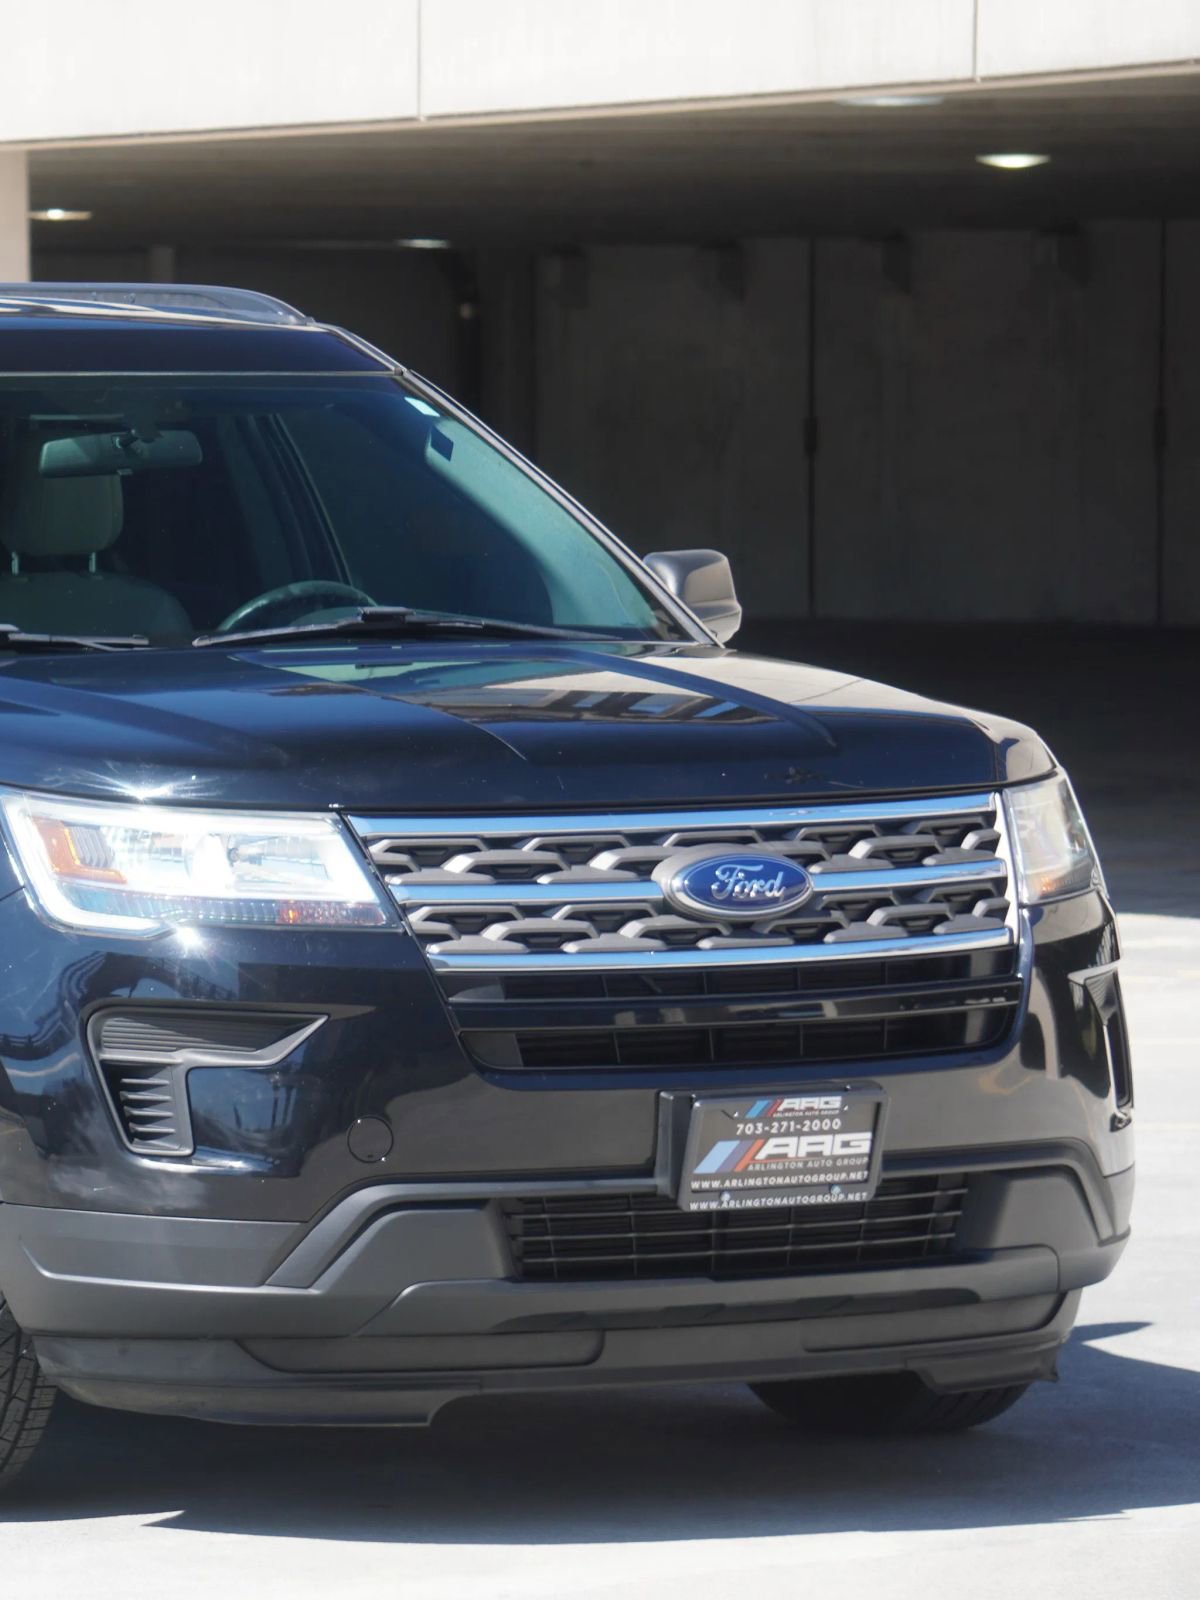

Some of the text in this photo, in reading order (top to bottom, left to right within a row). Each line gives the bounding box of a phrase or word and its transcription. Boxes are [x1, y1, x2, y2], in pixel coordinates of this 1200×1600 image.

[711, 864, 786, 900] Ford
[777, 1096, 842, 1111] AAG
[736, 1118, 842, 1135] 703-271-2000
[755, 1132, 872, 1160] AAG
[748, 1157, 869, 1171] ARLINGTON AUTO GROUP
[691, 1171, 869, 1189] WWW.ARLINGTONAUTOGROUP.NET
[689, 1192, 868, 1211] WWW.ARLINGTONAUTOGROUP.NET
